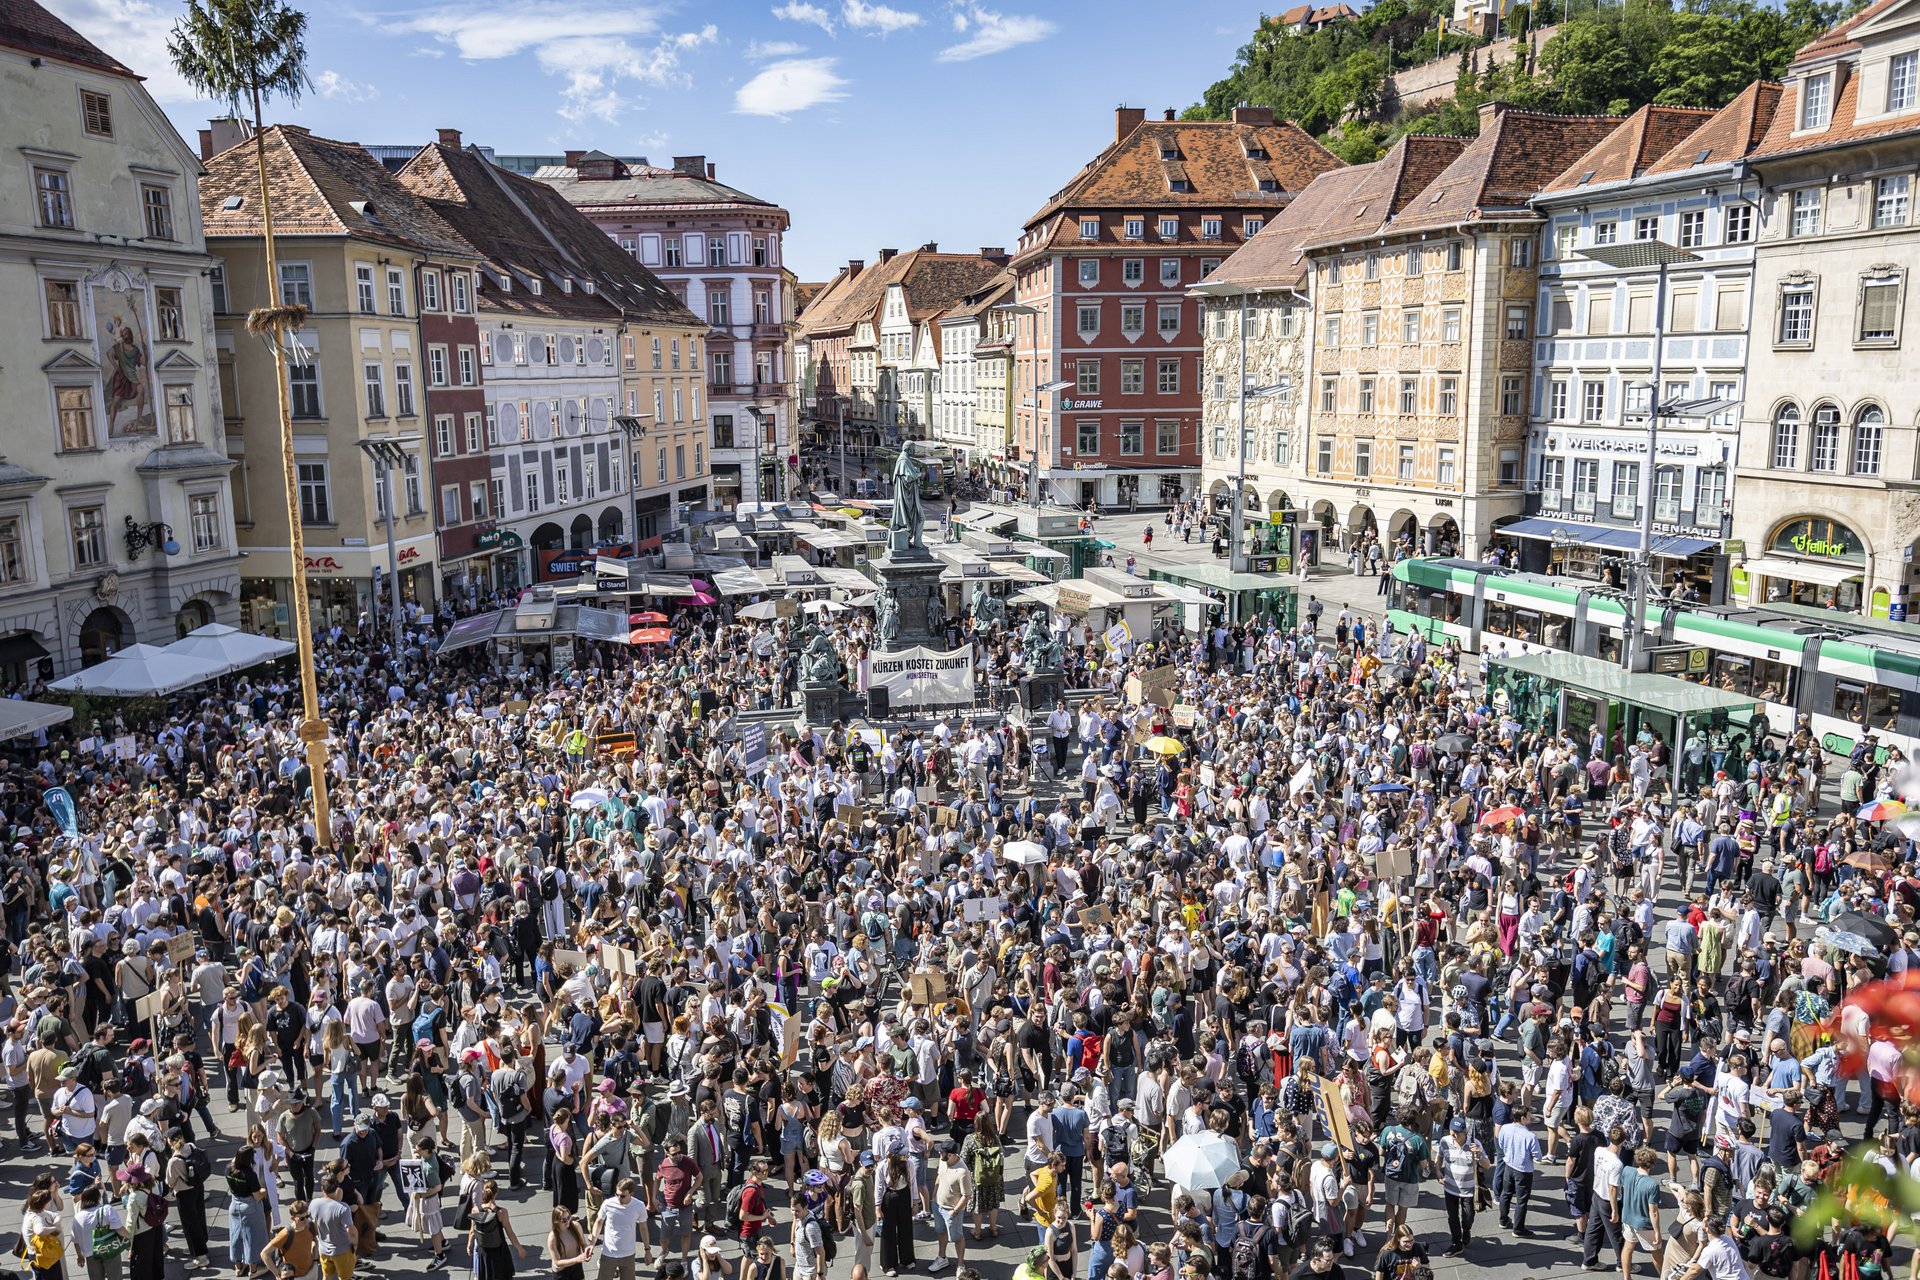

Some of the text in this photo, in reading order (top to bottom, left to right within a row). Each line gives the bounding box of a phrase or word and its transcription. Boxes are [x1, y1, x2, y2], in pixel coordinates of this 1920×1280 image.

[1074, 400, 1103, 408] GRAWE
[1567, 438, 1697, 455] WEIKHARDAUS
[1536, 509, 1594, 522] JUWELIER
[1634, 521, 1721, 538] URENHAUS
[1806, 539, 1843, 556] fellhof
[977, 566, 987, 574] 14
[801, 574, 811, 582] 12
[1061, 590, 1090, 602] BILDUNG
[1140, 587, 1150, 596] 15
[541, 619, 547, 628] 7
[872, 657, 969, 674] KÜRZEN KOSTET ZUKUNFT
